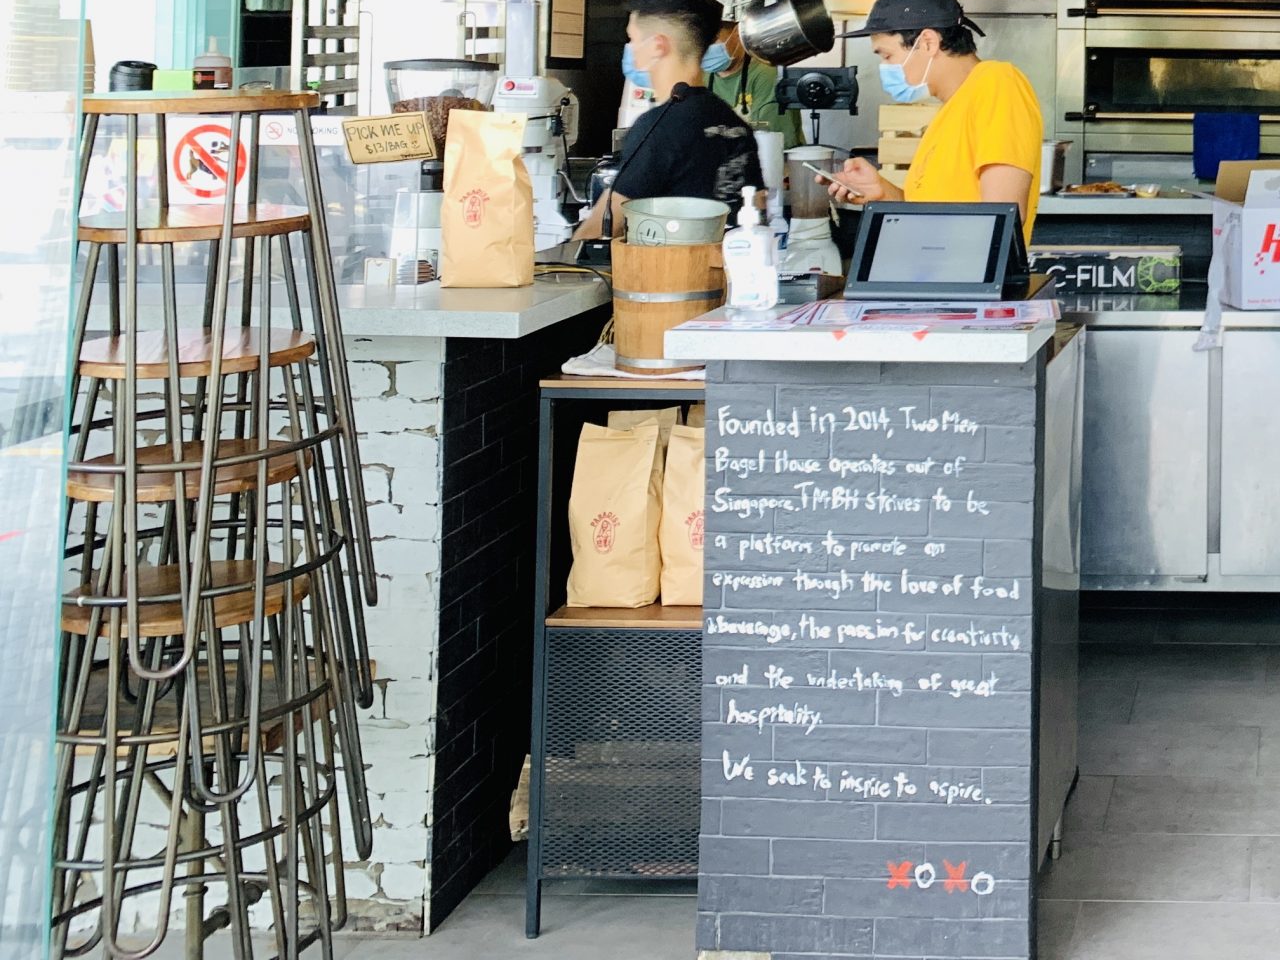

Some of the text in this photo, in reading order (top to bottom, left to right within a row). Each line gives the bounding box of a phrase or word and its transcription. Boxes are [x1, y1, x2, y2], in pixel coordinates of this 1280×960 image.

[346, 121, 423, 142] PICK ME UP
[1046, 264, 1136, 288] C-FILM
[717, 405, 799, 438] Founded
[810, 406, 835, 434] in
[899, 406, 939, 434] Two
[941, 411, 980, 437] Men
[714, 446, 967, 479] Bagel House operates out of
[711, 487, 800, 519] Singapore.
[794, 481, 860, 511] TMBH
[932, 487, 952, 512] to
[966, 490, 991, 516] be
[714, 530, 946, 561] a platform to promote an
[860, 570, 893, 594] the
[900, 569, 939, 594] love
[941, 575, 965, 595] of
[970, 576, 1020, 601] food
[798, 613, 832, 640] the
[837, 619, 899, 643] passion
[901, 617, 927, 642] for
[715, 664, 1001, 698] and the undertaking of great
[726, 698, 824, 736] hospitality.
[721, 749, 993, 808] We seek to inspire to aspire.
